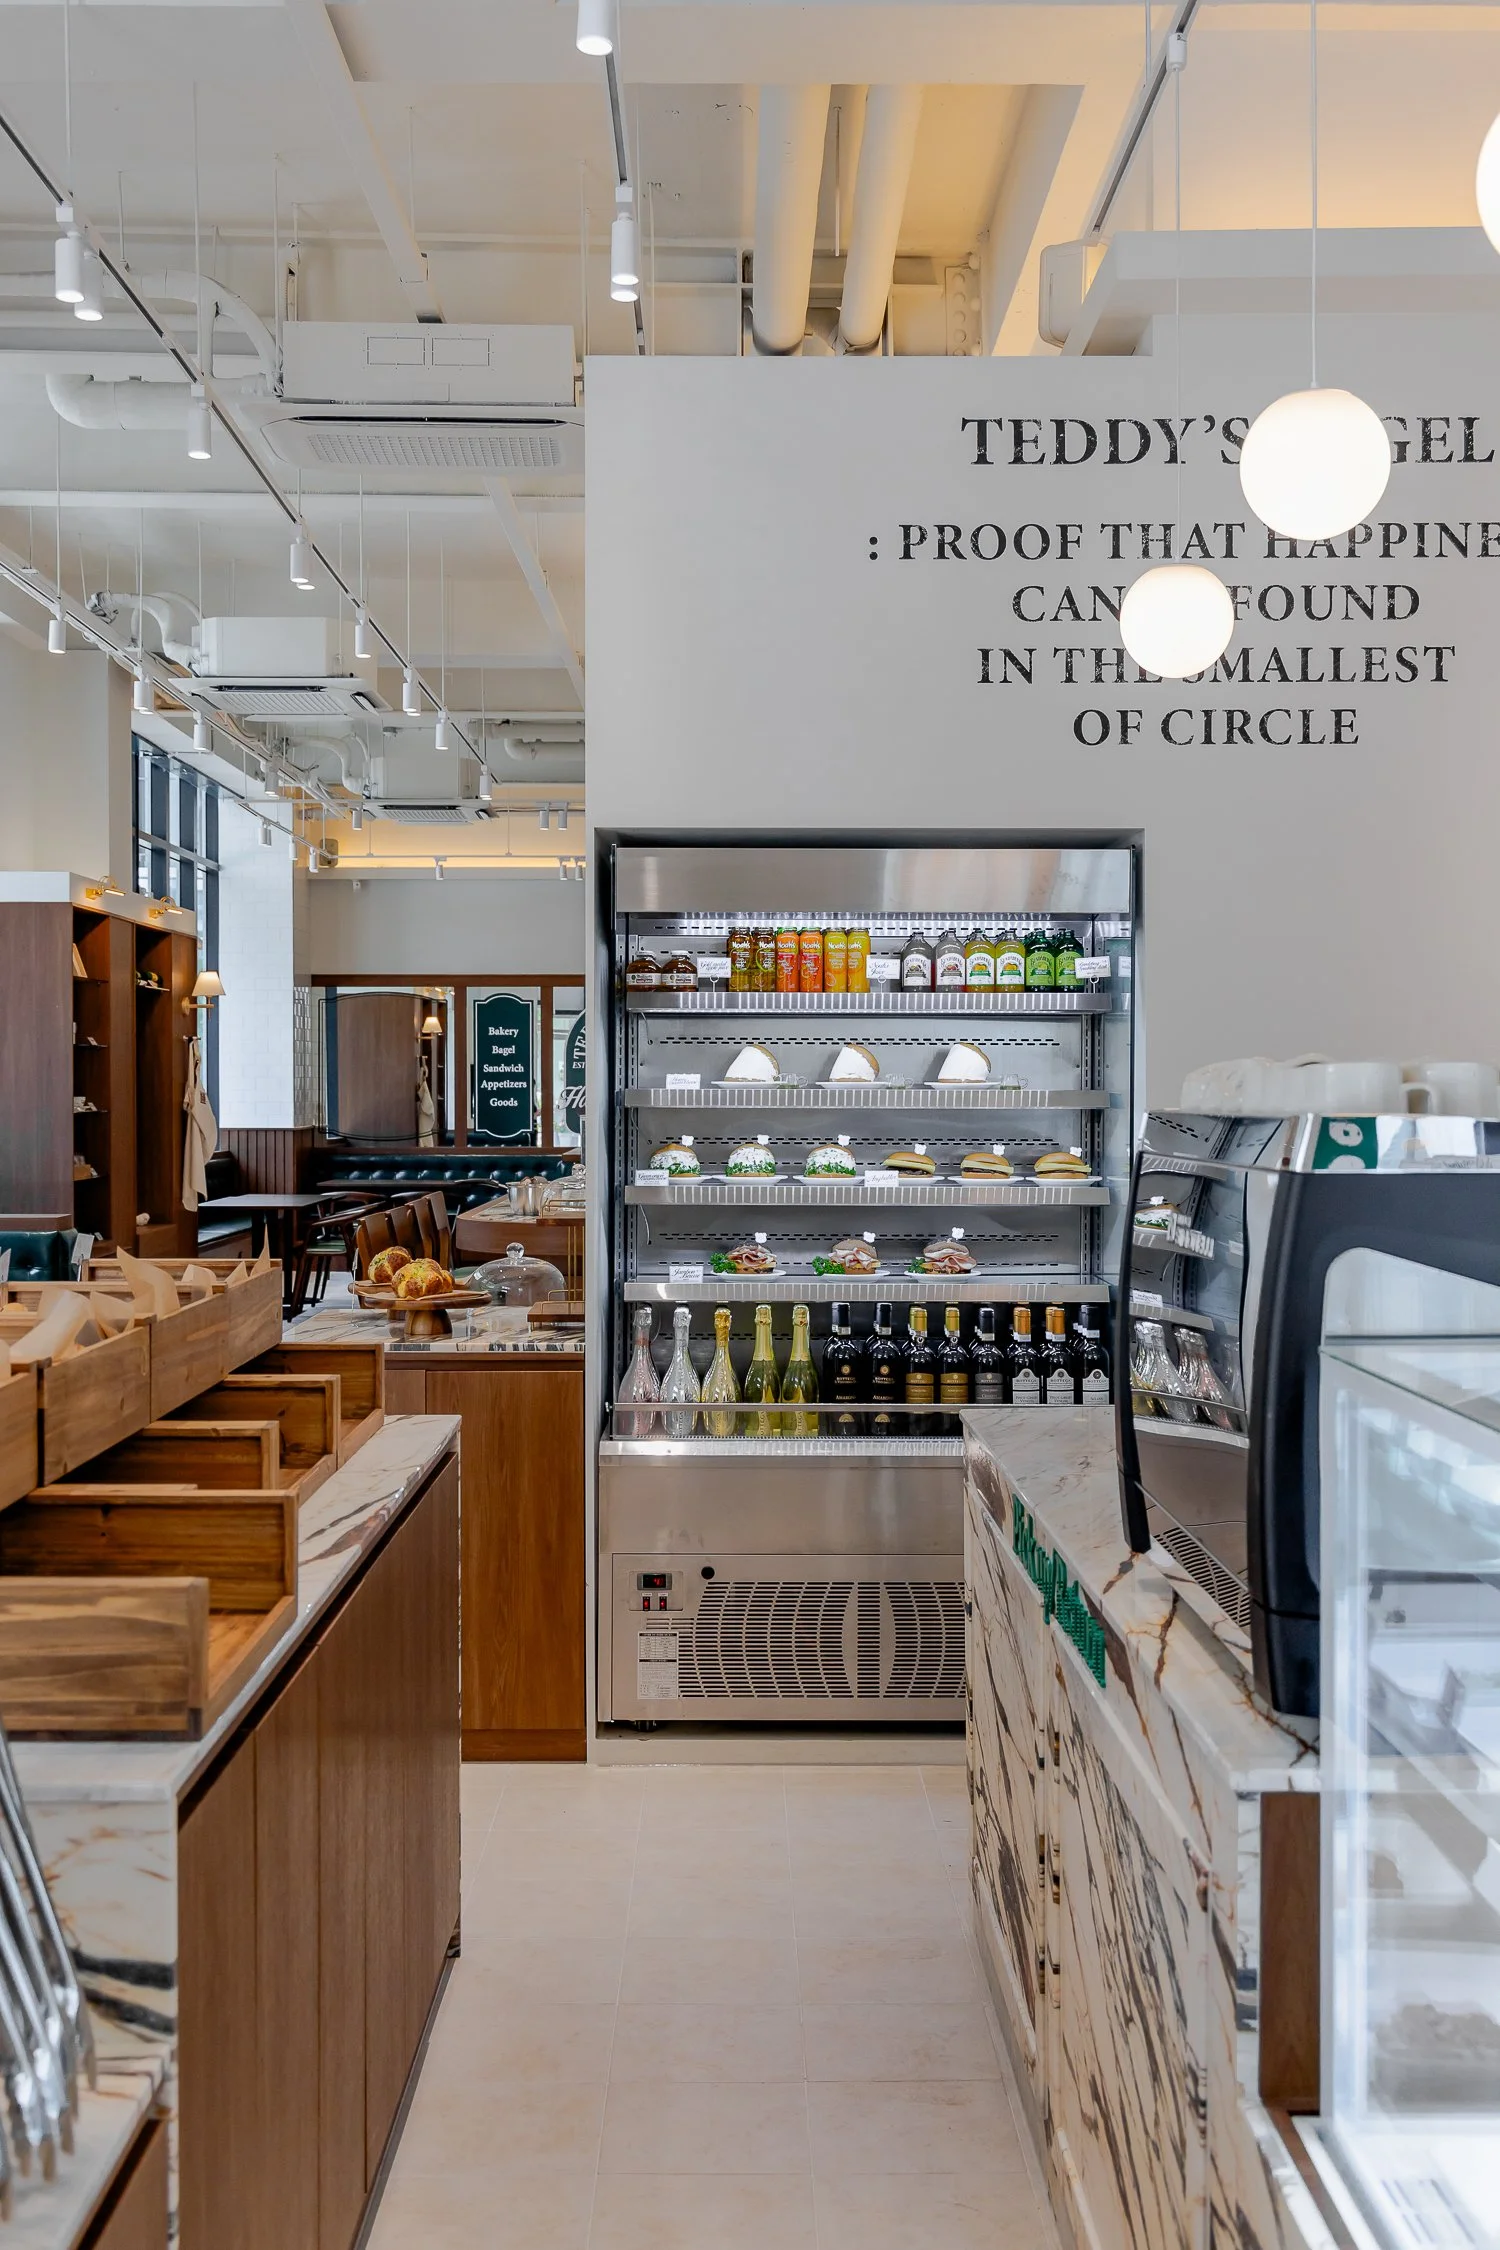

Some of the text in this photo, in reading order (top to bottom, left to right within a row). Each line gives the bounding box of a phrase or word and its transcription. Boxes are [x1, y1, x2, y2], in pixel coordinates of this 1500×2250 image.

[898, 522, 1084, 561] PROOF
[1099, 521, 1246, 560] THAT
[1011, 584, 1420, 623] CAN FOUND
[976, 645, 1457, 685] IN TH MALLEST
[1073, 708, 1359, 746] OF CIRCLE
[488, 1026, 519, 1038] Bakery
[491, 1045, 516, 1056] Bagel
[483, 1064, 524, 1073] Sandwich
[480, 1080, 527, 1090] Appetizers
[489, 1098, 519, 1107] Goods
